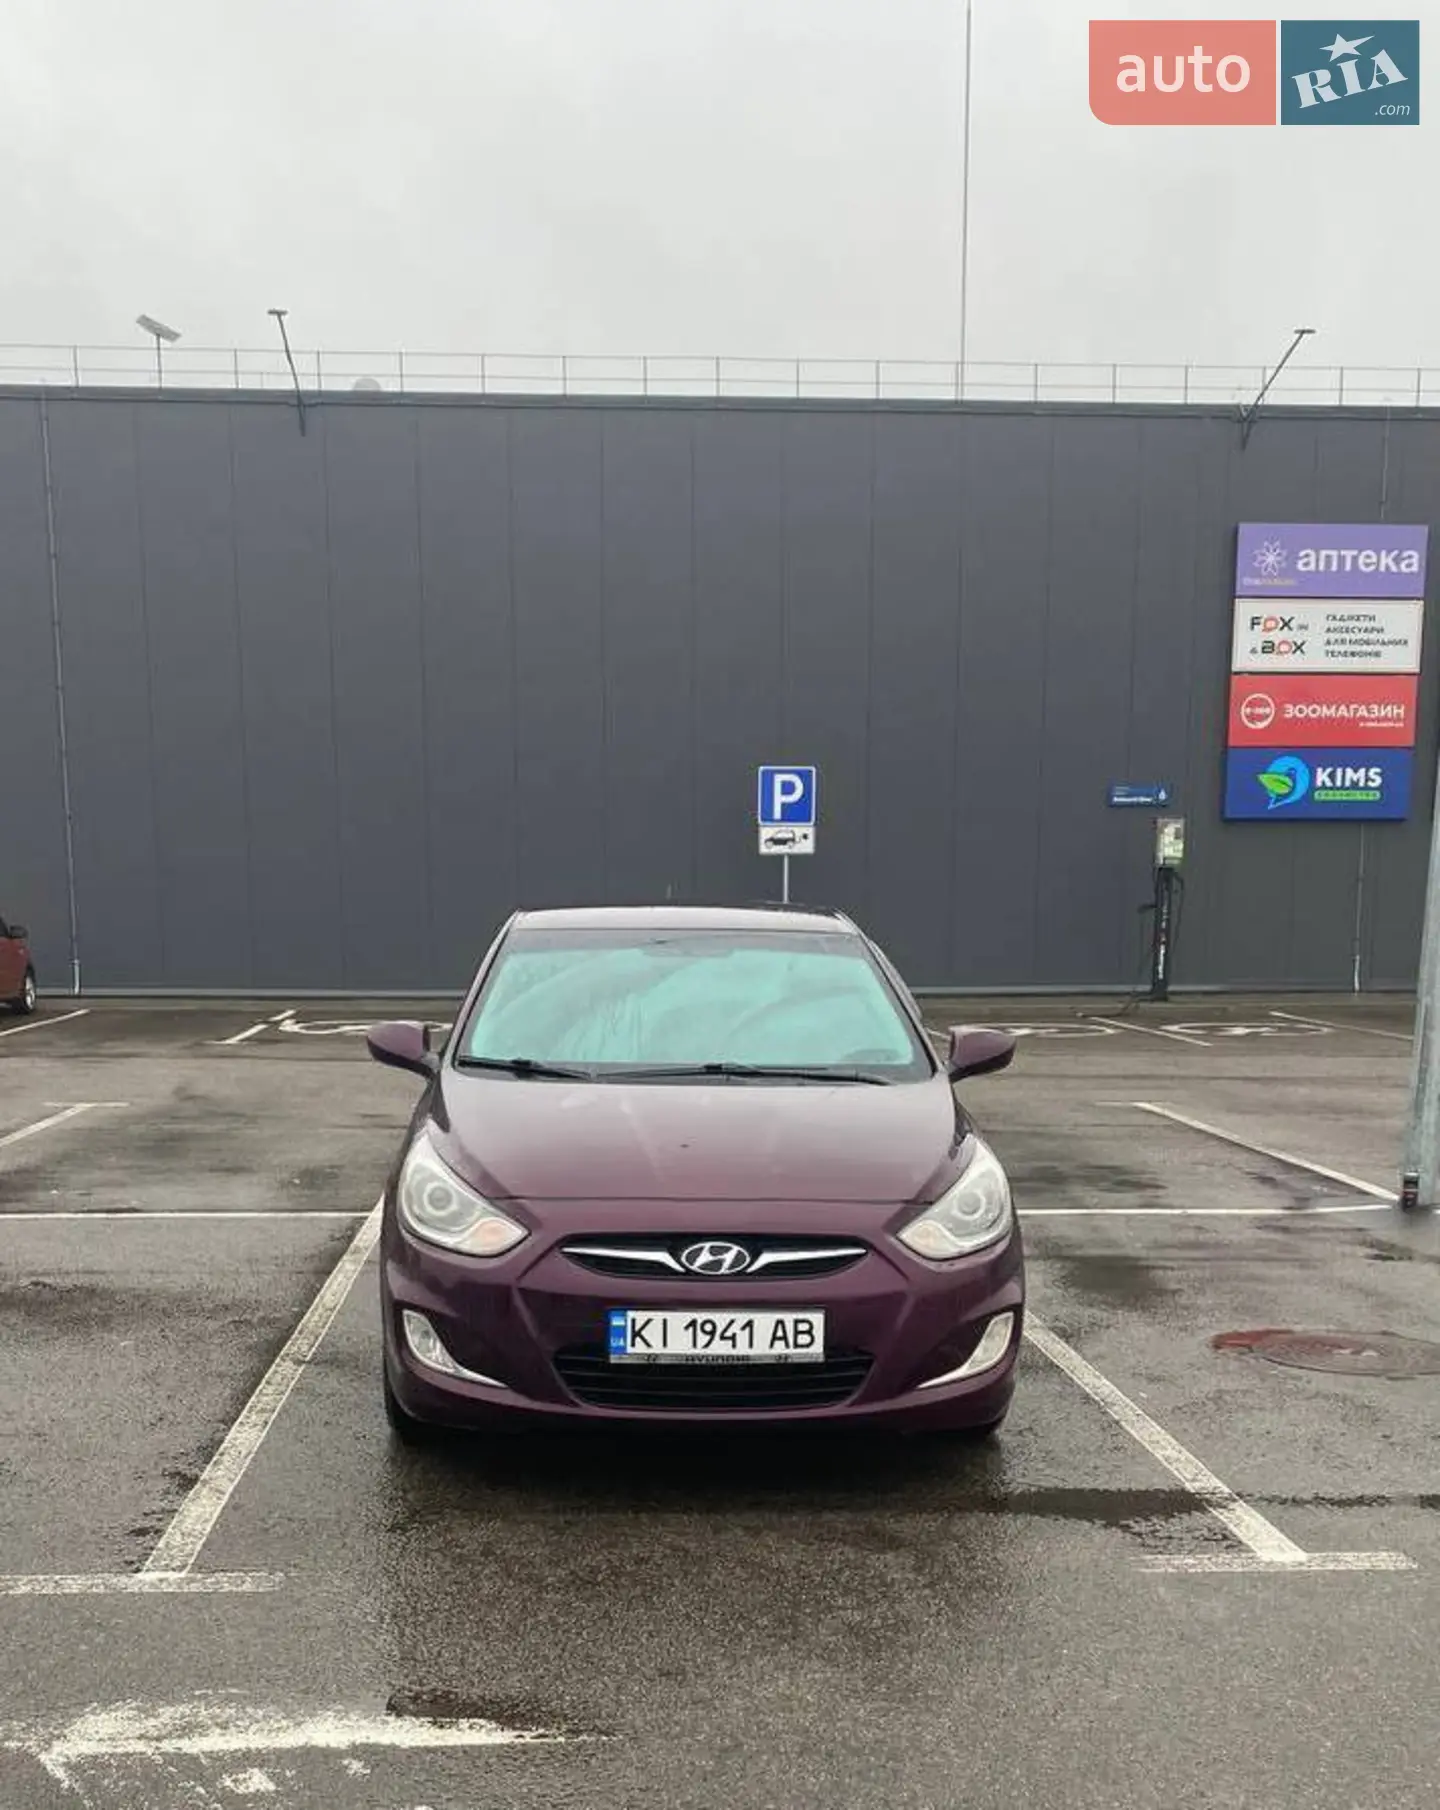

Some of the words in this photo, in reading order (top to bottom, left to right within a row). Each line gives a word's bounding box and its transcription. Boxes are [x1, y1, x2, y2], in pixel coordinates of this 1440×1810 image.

[1297, 549, 1420, 573] аптека
[1250, 616, 1295, 632] FOX
[1261, 640, 1307, 655] BOX
[1283, 704, 1405, 719] ЗООМАГАЗИН
[1315, 767, 1383, 788] KIMS
[773, 773, 804, 820] P
[630, 1318, 668, 1349] KI
[682, 1318, 754, 1349] 1941
[769, 1319, 816, 1349] AB
